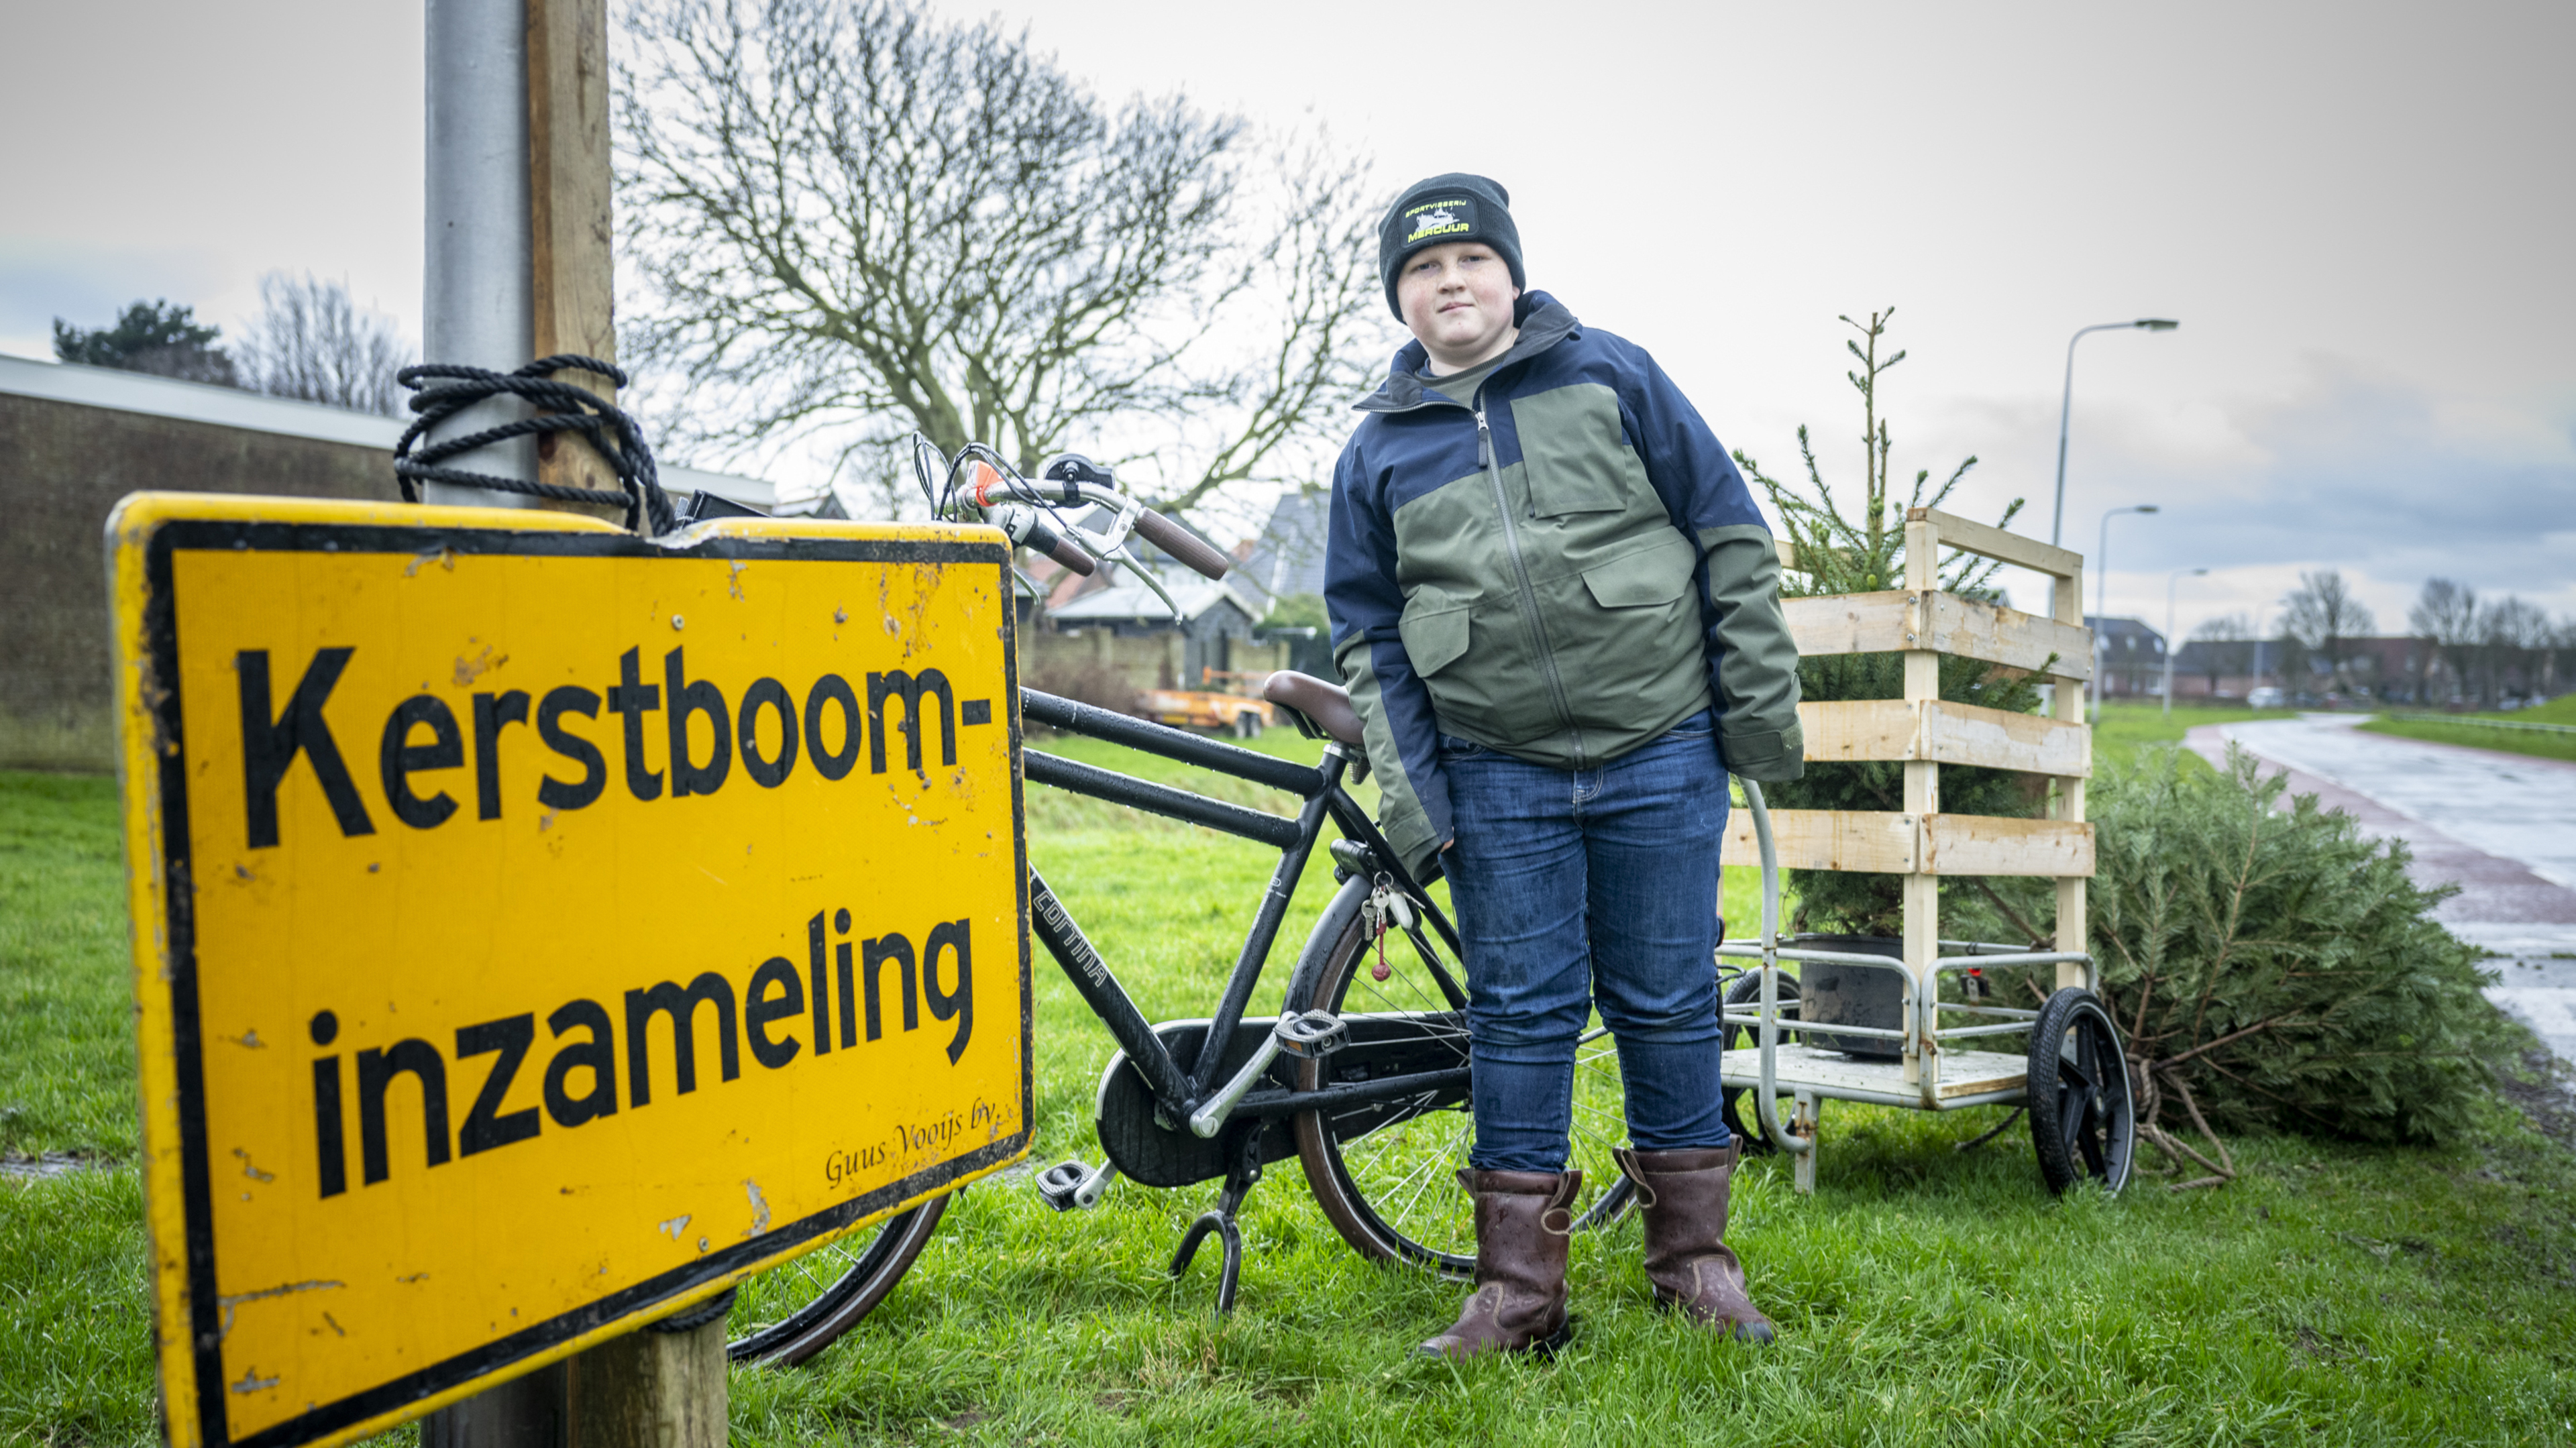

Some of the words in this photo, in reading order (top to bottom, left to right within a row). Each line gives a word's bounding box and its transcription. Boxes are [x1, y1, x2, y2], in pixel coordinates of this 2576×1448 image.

[1405, 200, 1466, 218] SPORTVISSERIJ
[1408, 223, 1469, 243] MERCUUR
[235, 645, 991, 849] Kerstboom-
[1033, 890, 1108, 987] CORTINA
[309, 907, 974, 1201] inzameling
[826, 1141, 886, 1190] Guus
[894, 1109, 963, 1154] Vooijs
